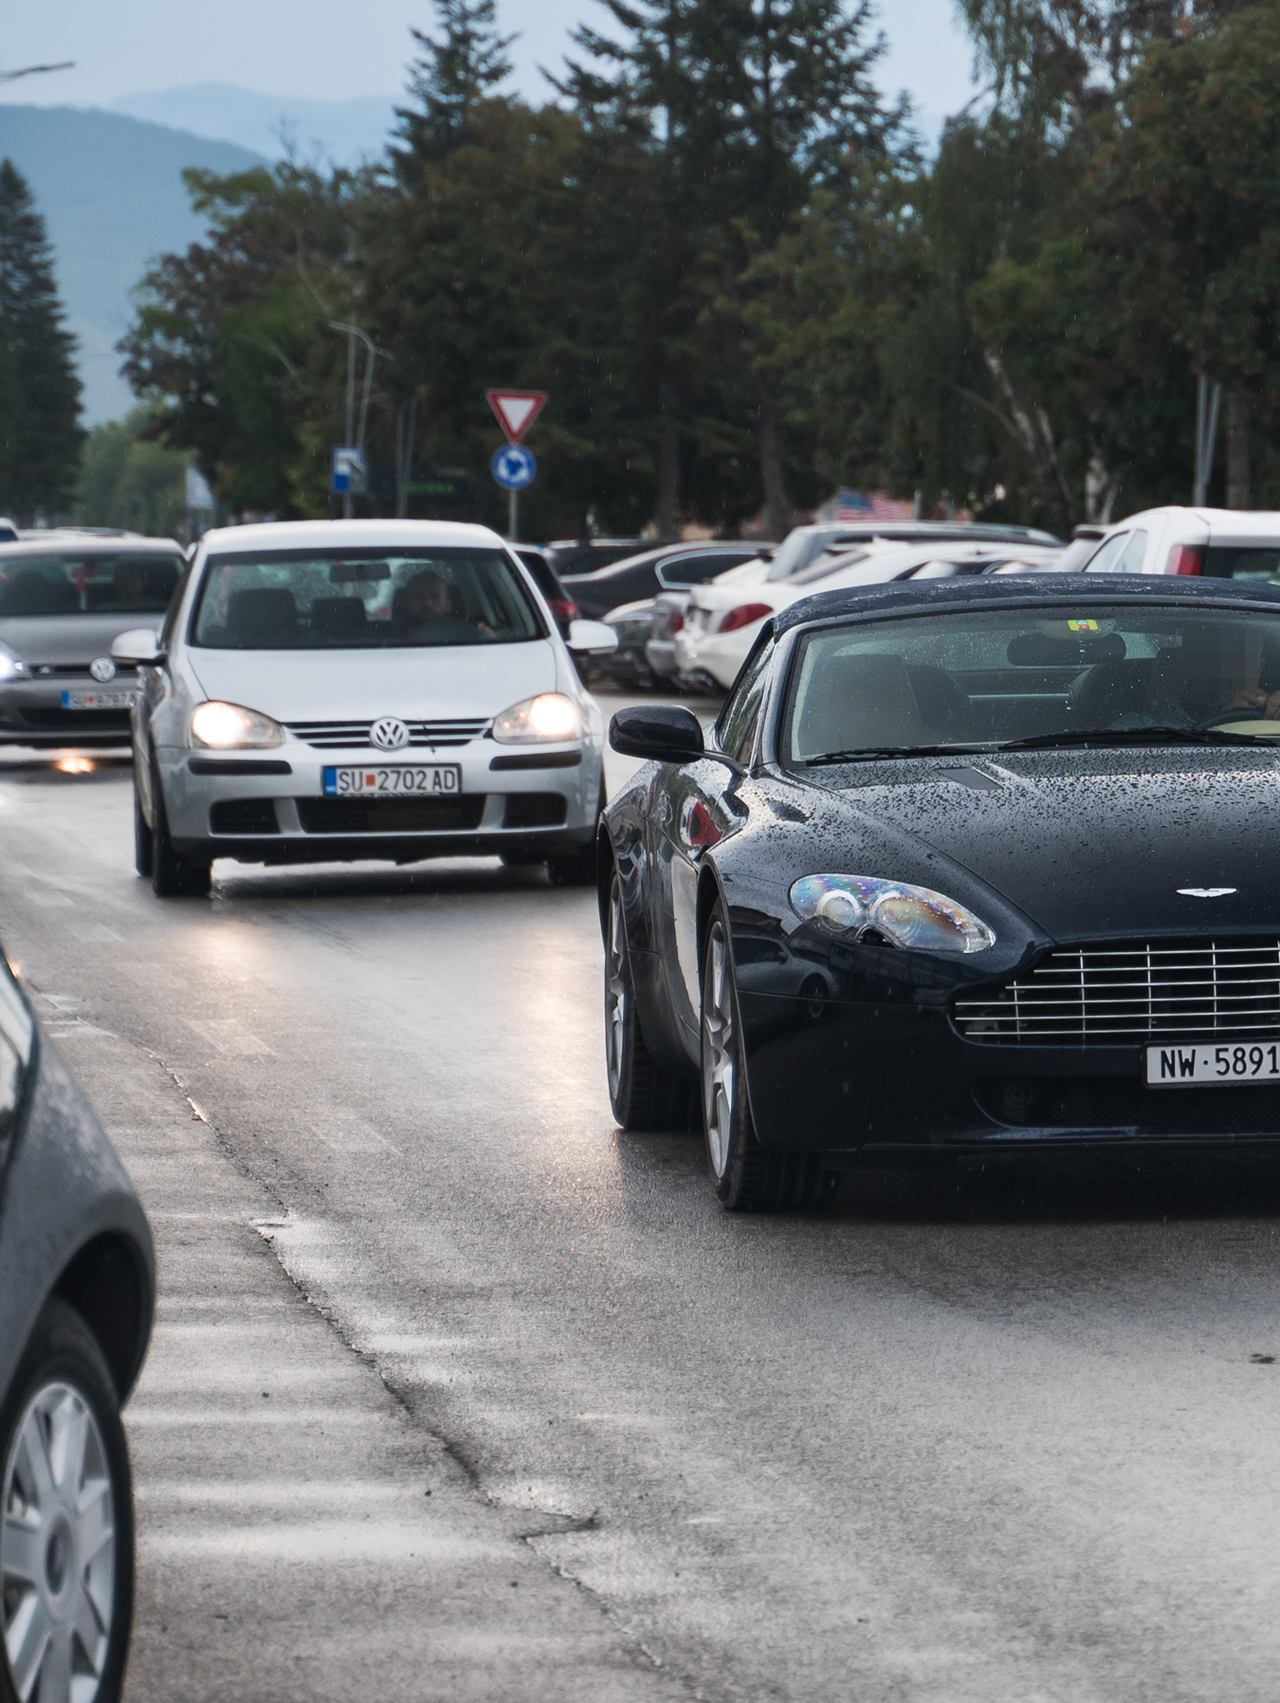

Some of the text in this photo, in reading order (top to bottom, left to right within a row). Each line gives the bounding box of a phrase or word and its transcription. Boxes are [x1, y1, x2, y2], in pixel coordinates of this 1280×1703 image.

[339, 769, 455, 792] SU 2702 AD
